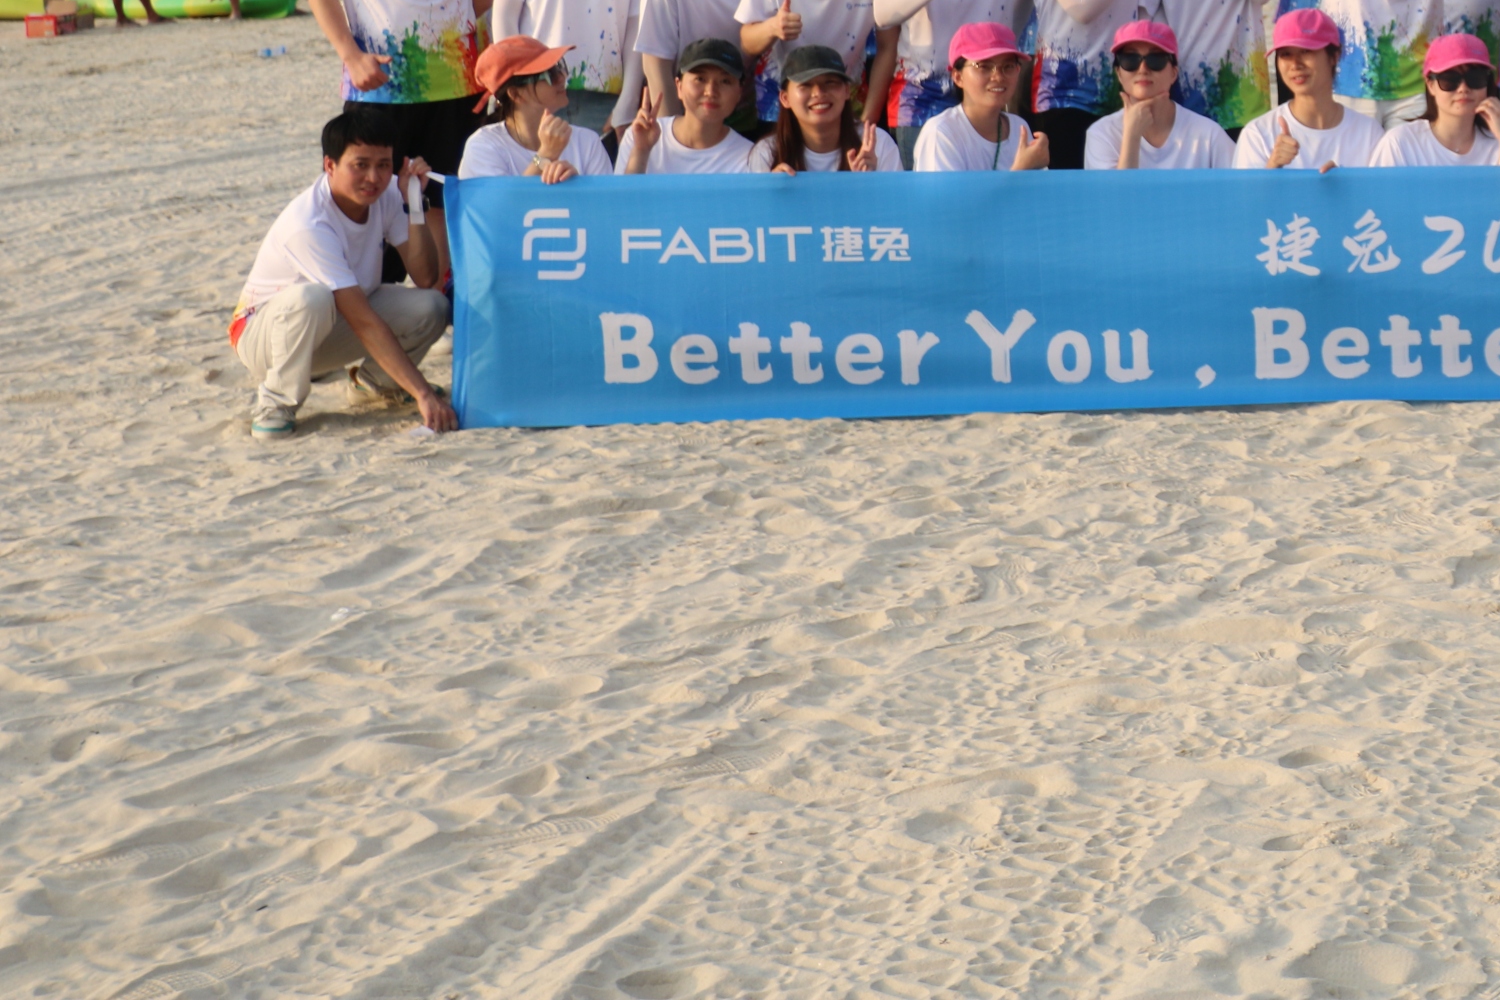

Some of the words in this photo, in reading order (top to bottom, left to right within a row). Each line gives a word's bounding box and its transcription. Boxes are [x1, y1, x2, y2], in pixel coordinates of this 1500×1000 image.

[621, 226, 813, 264] FABIT
[820, 226, 912, 263] 捷兔
[599, 311, 941, 386] Better
